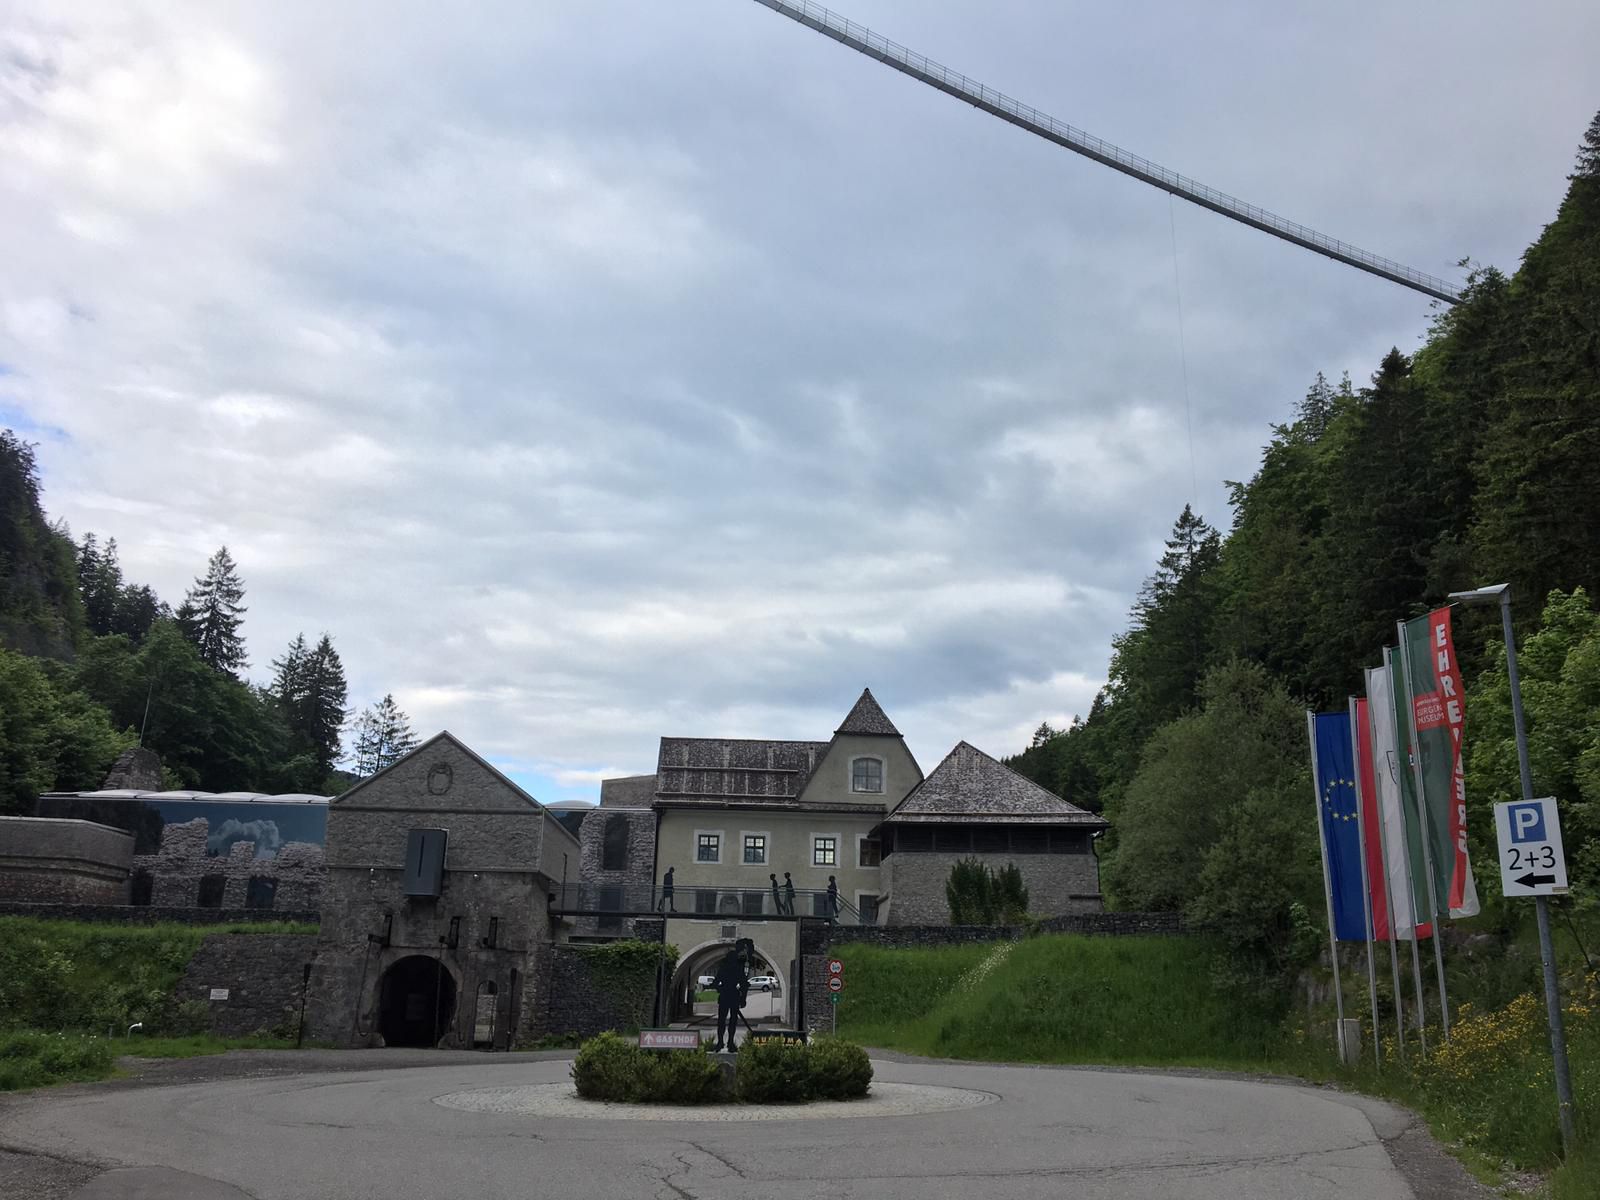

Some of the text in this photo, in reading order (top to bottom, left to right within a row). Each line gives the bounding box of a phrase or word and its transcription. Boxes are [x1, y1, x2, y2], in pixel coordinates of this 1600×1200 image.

[1417, 711, 1445, 725] MUSEUM
[1515, 808, 1539, 839] P
[1507, 845, 1556, 871] 2+3
[655, 1035, 695, 1044] GASTHOF
